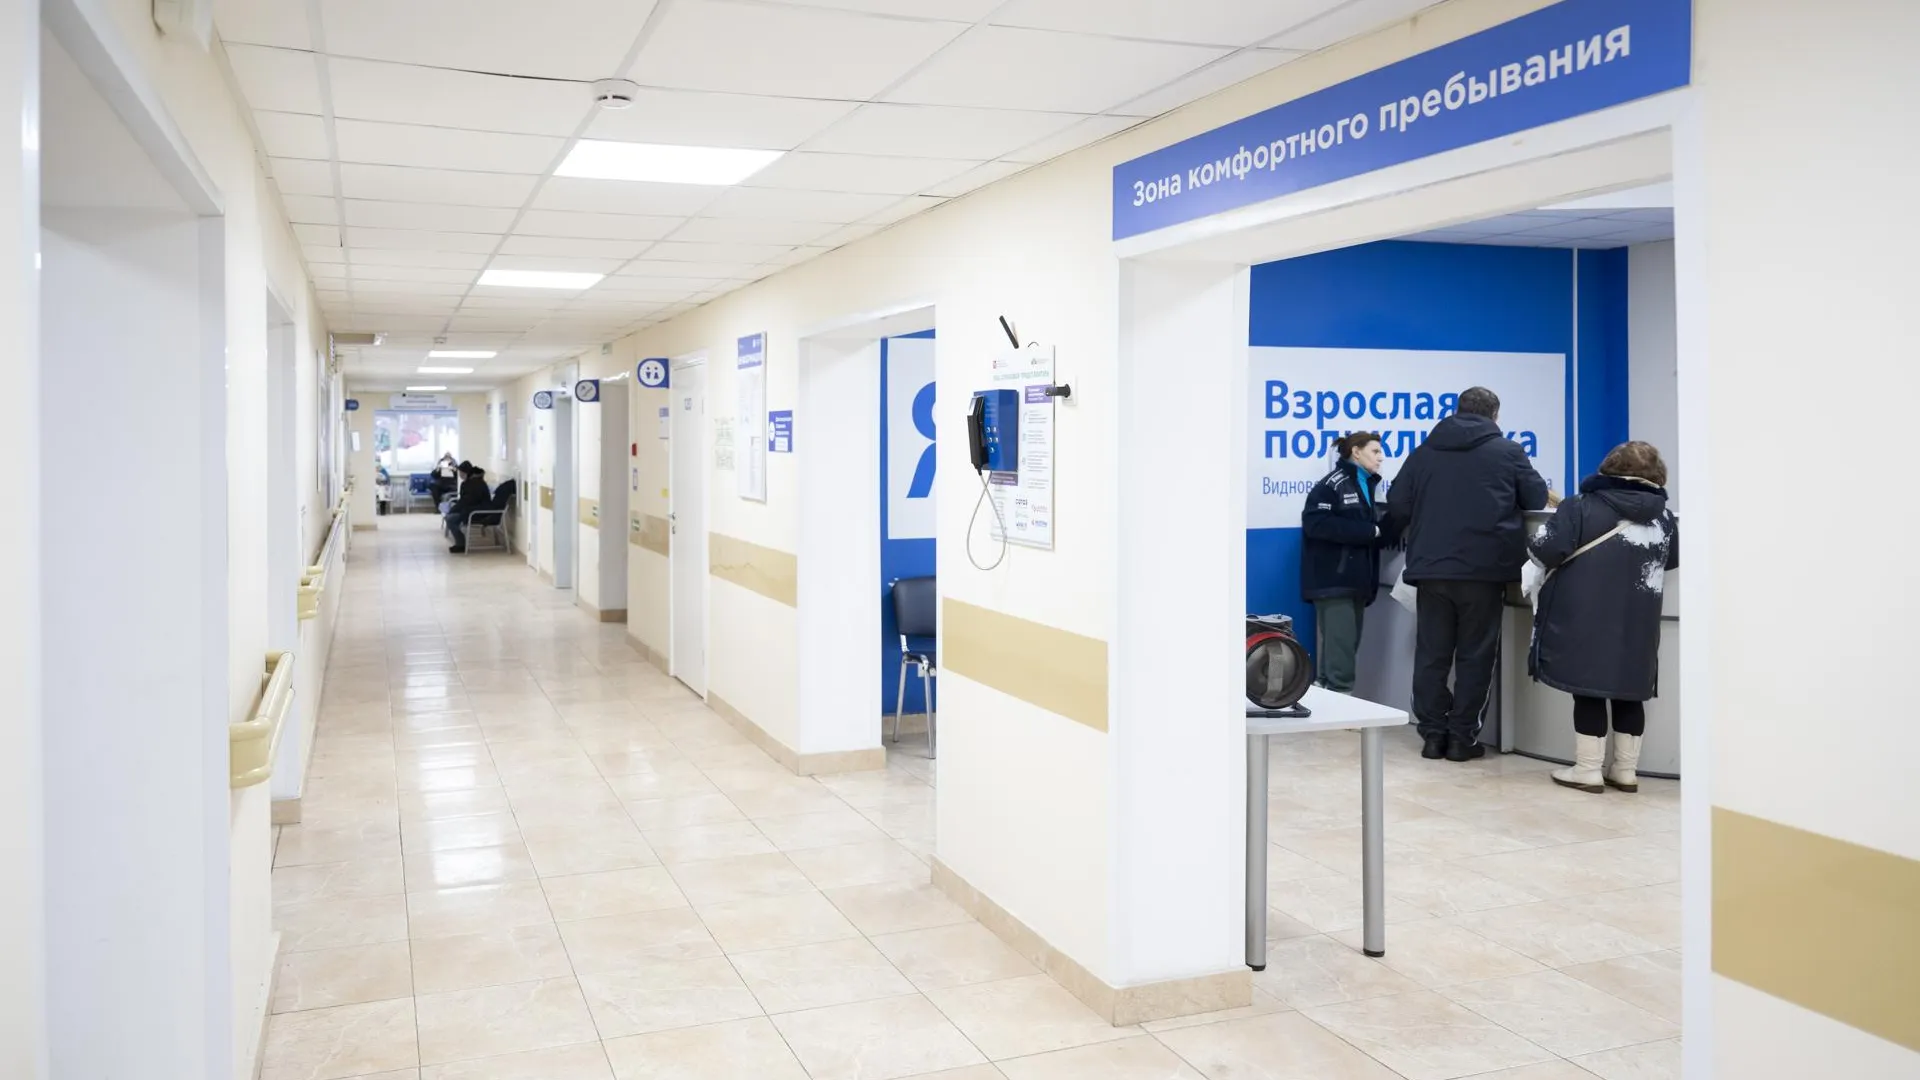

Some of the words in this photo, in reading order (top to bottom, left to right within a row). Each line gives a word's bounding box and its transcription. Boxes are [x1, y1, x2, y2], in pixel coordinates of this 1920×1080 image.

[1133, 174, 1181, 206] Зона
[1188, 113, 1369, 180] комфортного
[1379, 24, 1631, 132] пребывания
